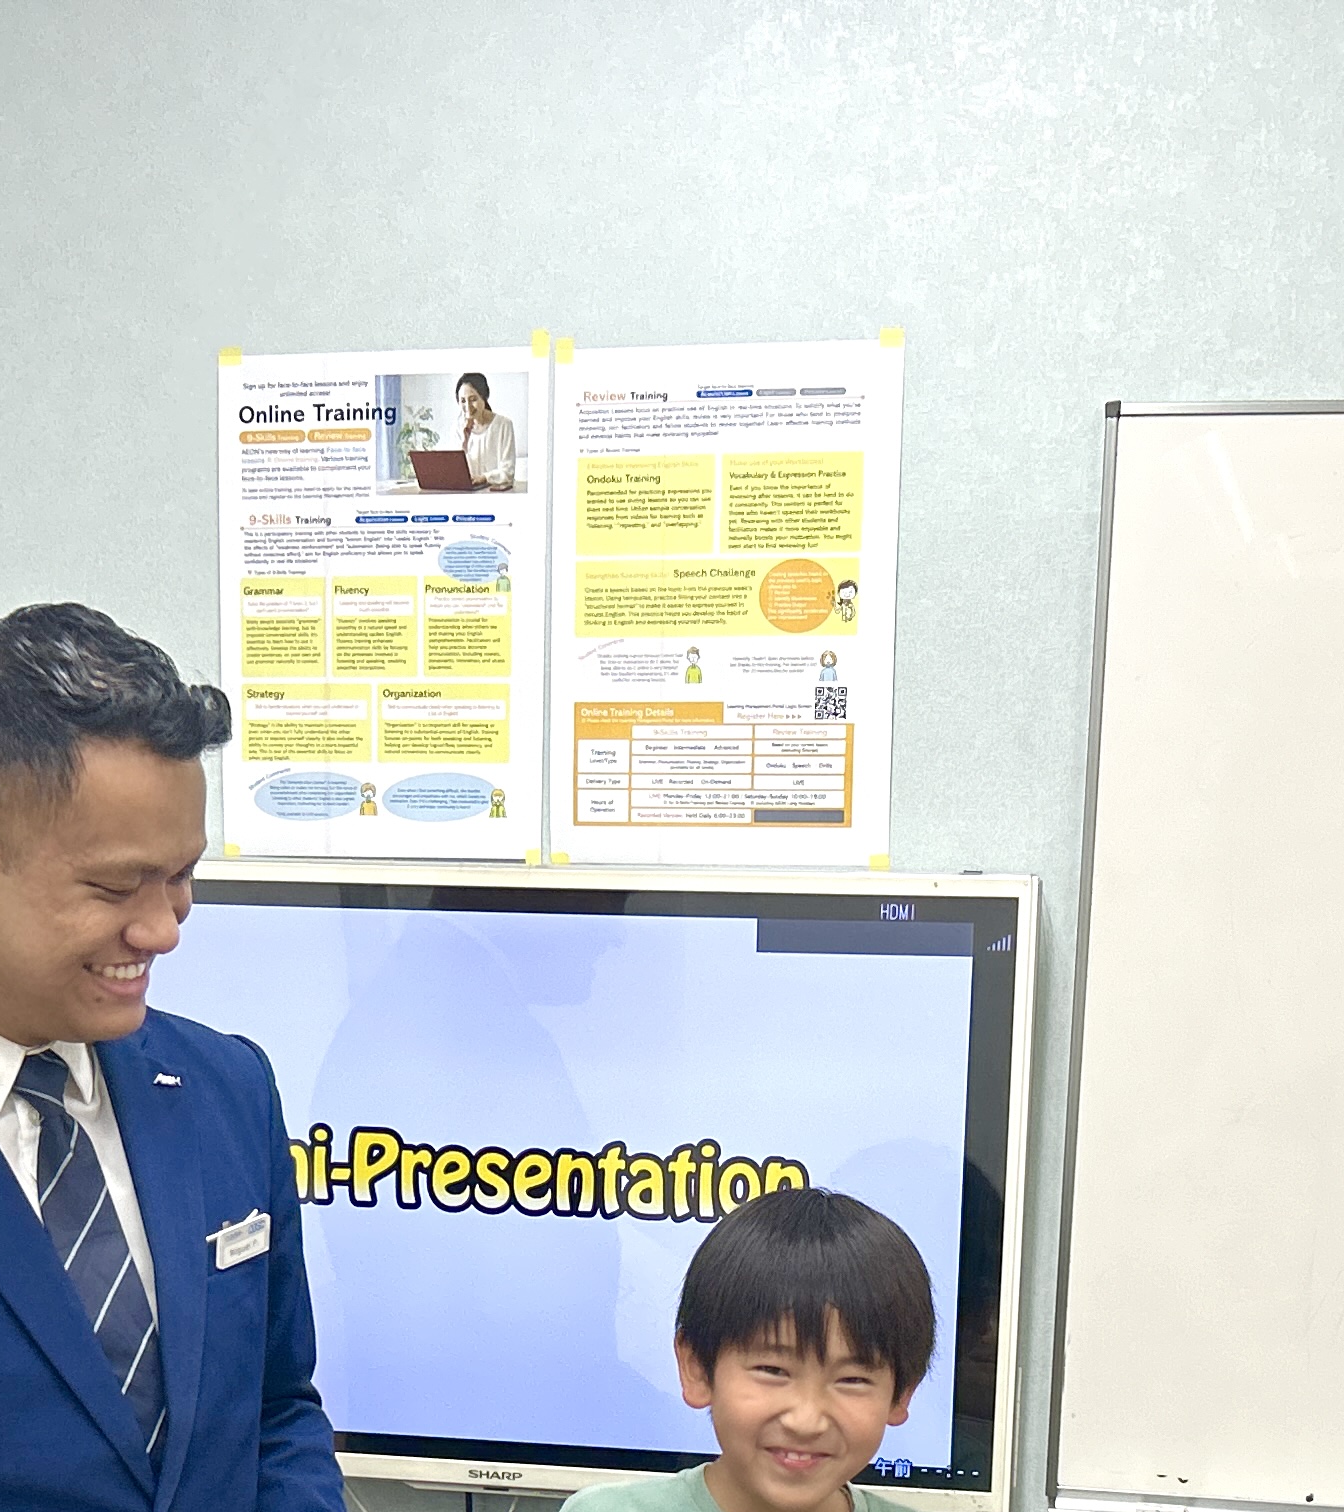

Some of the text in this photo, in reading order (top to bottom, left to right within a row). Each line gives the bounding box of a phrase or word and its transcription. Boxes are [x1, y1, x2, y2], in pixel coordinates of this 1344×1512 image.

[583, 391, 668, 402] Review Training
[239, 402, 397, 425] Online Training
[587, 473, 661, 484] Ondoku Training
[249, 514, 332, 527] 9-Skills Training
[673, 568, 756, 579] Speech Challenge
[243, 585, 284, 597] Grammar
[334, 585, 370, 597] Fluency
[425, 583, 490, 595] Pronunciation
[246, 688, 285, 700] Strategy
[382, 687, 442, 700] Organization
[580, 707, 674, 719] Online Training Details
[880, 903, 916, 921] HDMI
[874, 1457, 913, 1479] 午前
[468, 1468, 523, 1481] SHARP
